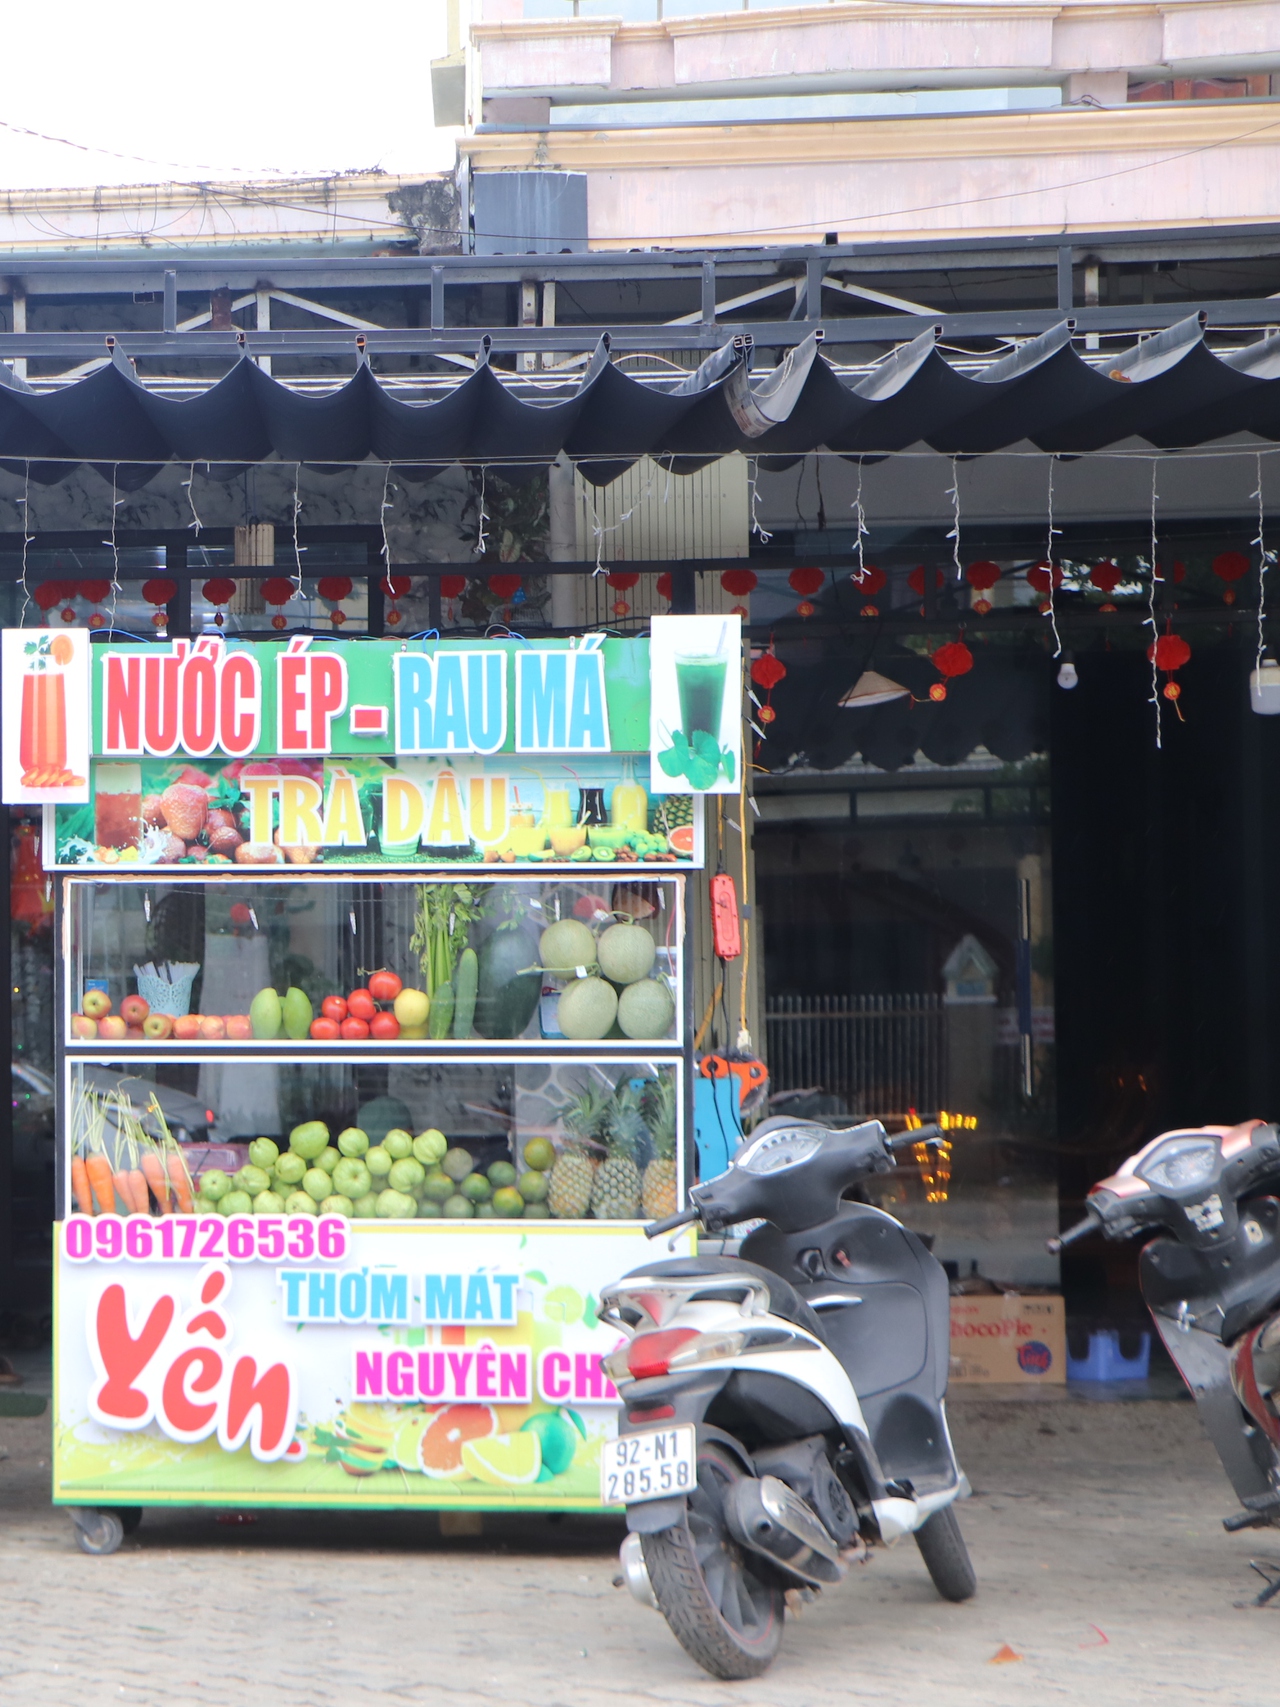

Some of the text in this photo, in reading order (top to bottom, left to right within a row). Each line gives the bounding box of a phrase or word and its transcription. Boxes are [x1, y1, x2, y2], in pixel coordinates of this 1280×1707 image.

[103, 637, 260, 756] NƯỚC
[277, 635, 346, 752] ÉP
[395, 650, 507, 756] RAU
[515, 634, 610, 752] MÁ
[241, 766, 510, 846] TRÀ DÂU
[66, 1218, 346, 1258] 0961726536
[281, 1266, 519, 1320] THƠM MÁT
[96, 1270, 291, 1452] Yến
[356, 1344, 527, 1397] NGUYÊN
[616, 1431, 677, 1467] 92-N1
[608, 1461, 689, 1500] 285.58
